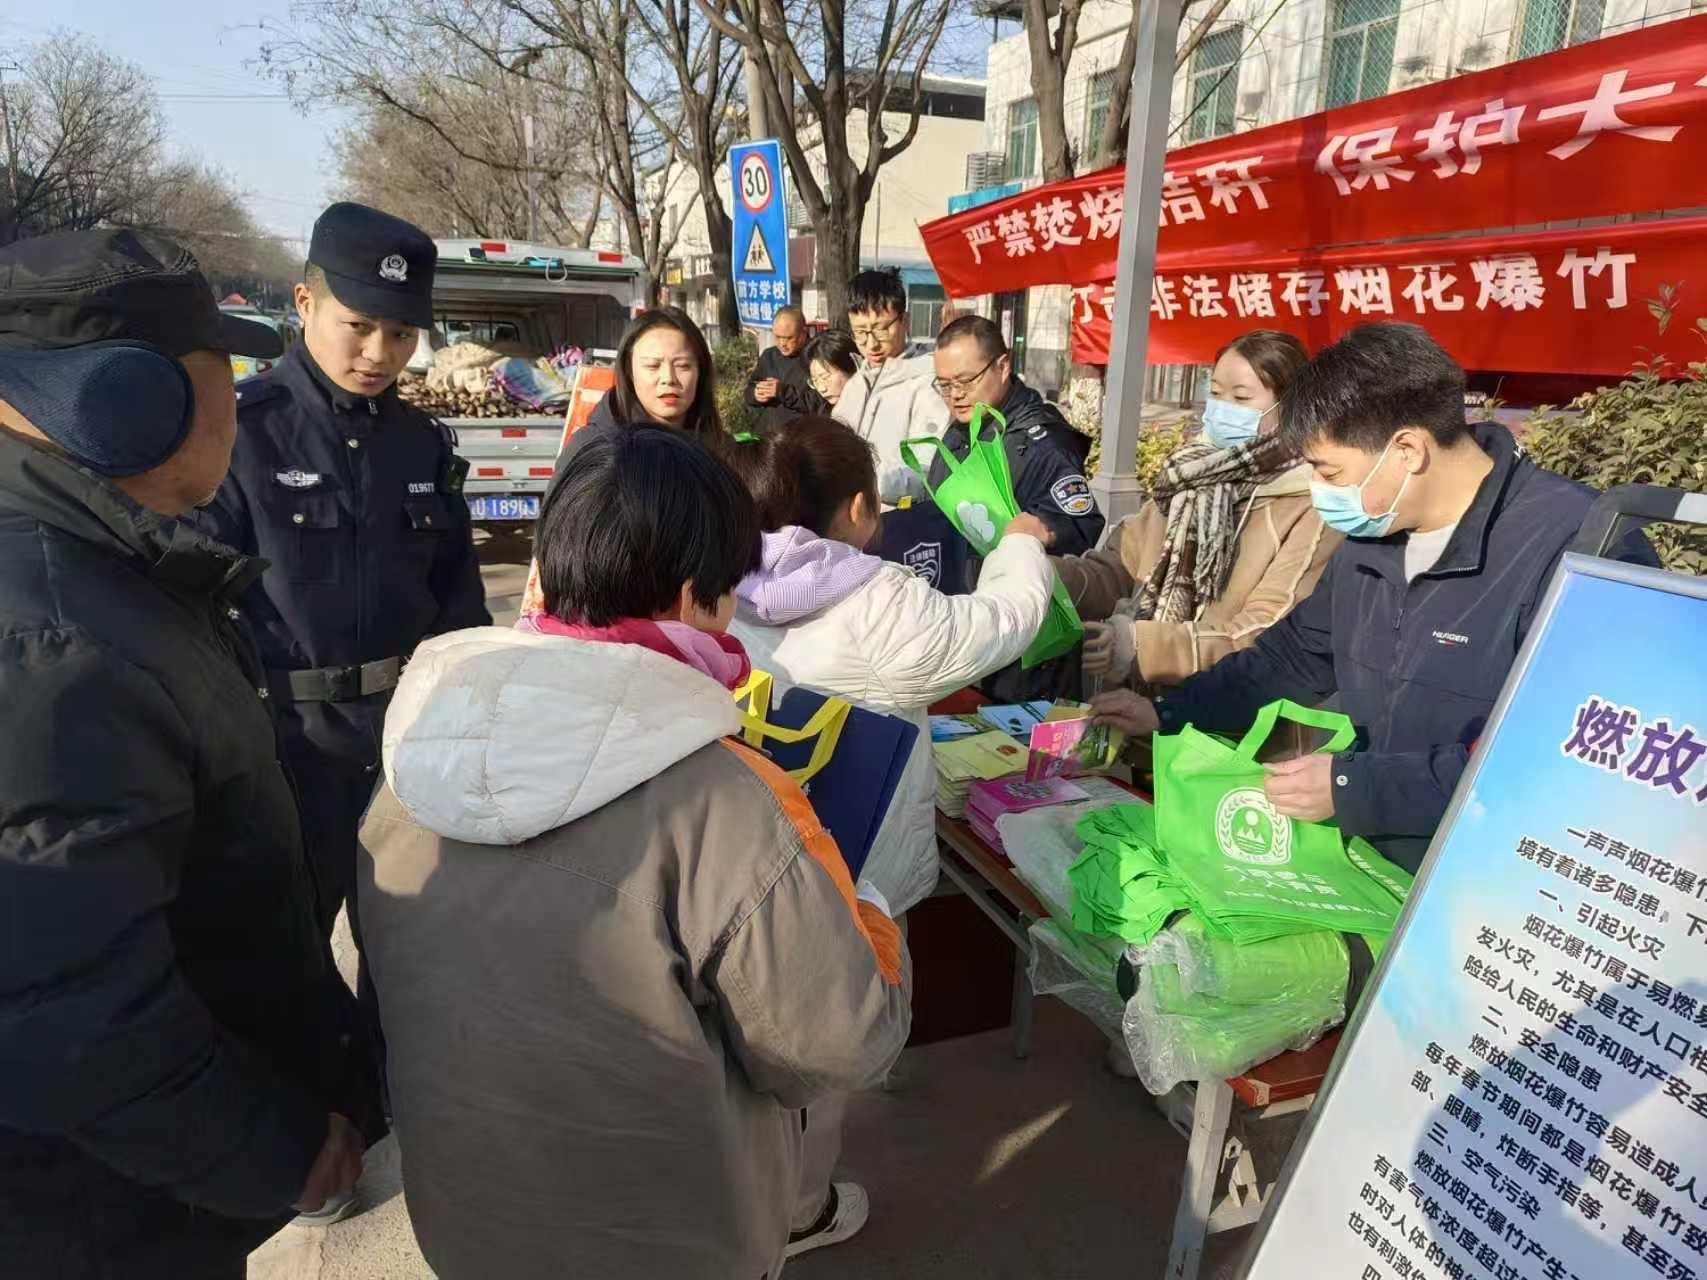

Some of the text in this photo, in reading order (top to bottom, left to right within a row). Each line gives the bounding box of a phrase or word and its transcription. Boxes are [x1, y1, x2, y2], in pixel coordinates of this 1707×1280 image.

[744, 166, 767, 197] 30
[1314, 69, 1707, 195] 保护大
[1564, 699, 1707, 802] 燃放
[1539, 889, 1665, 961] 一、引起火灾
[1481, 1005, 1603, 1092] 二、安全隐患
[1427, 1121, 1542, 1220] 三、空气污染
[1468, 1033, 1707, 1210] 燃放烟花爆竹容易造成人
[1373, 1154, 1530, 1280] 有害气体浓度超过
[1414, 1149, 1580, 1280] 燃放烟花爆竹产生
